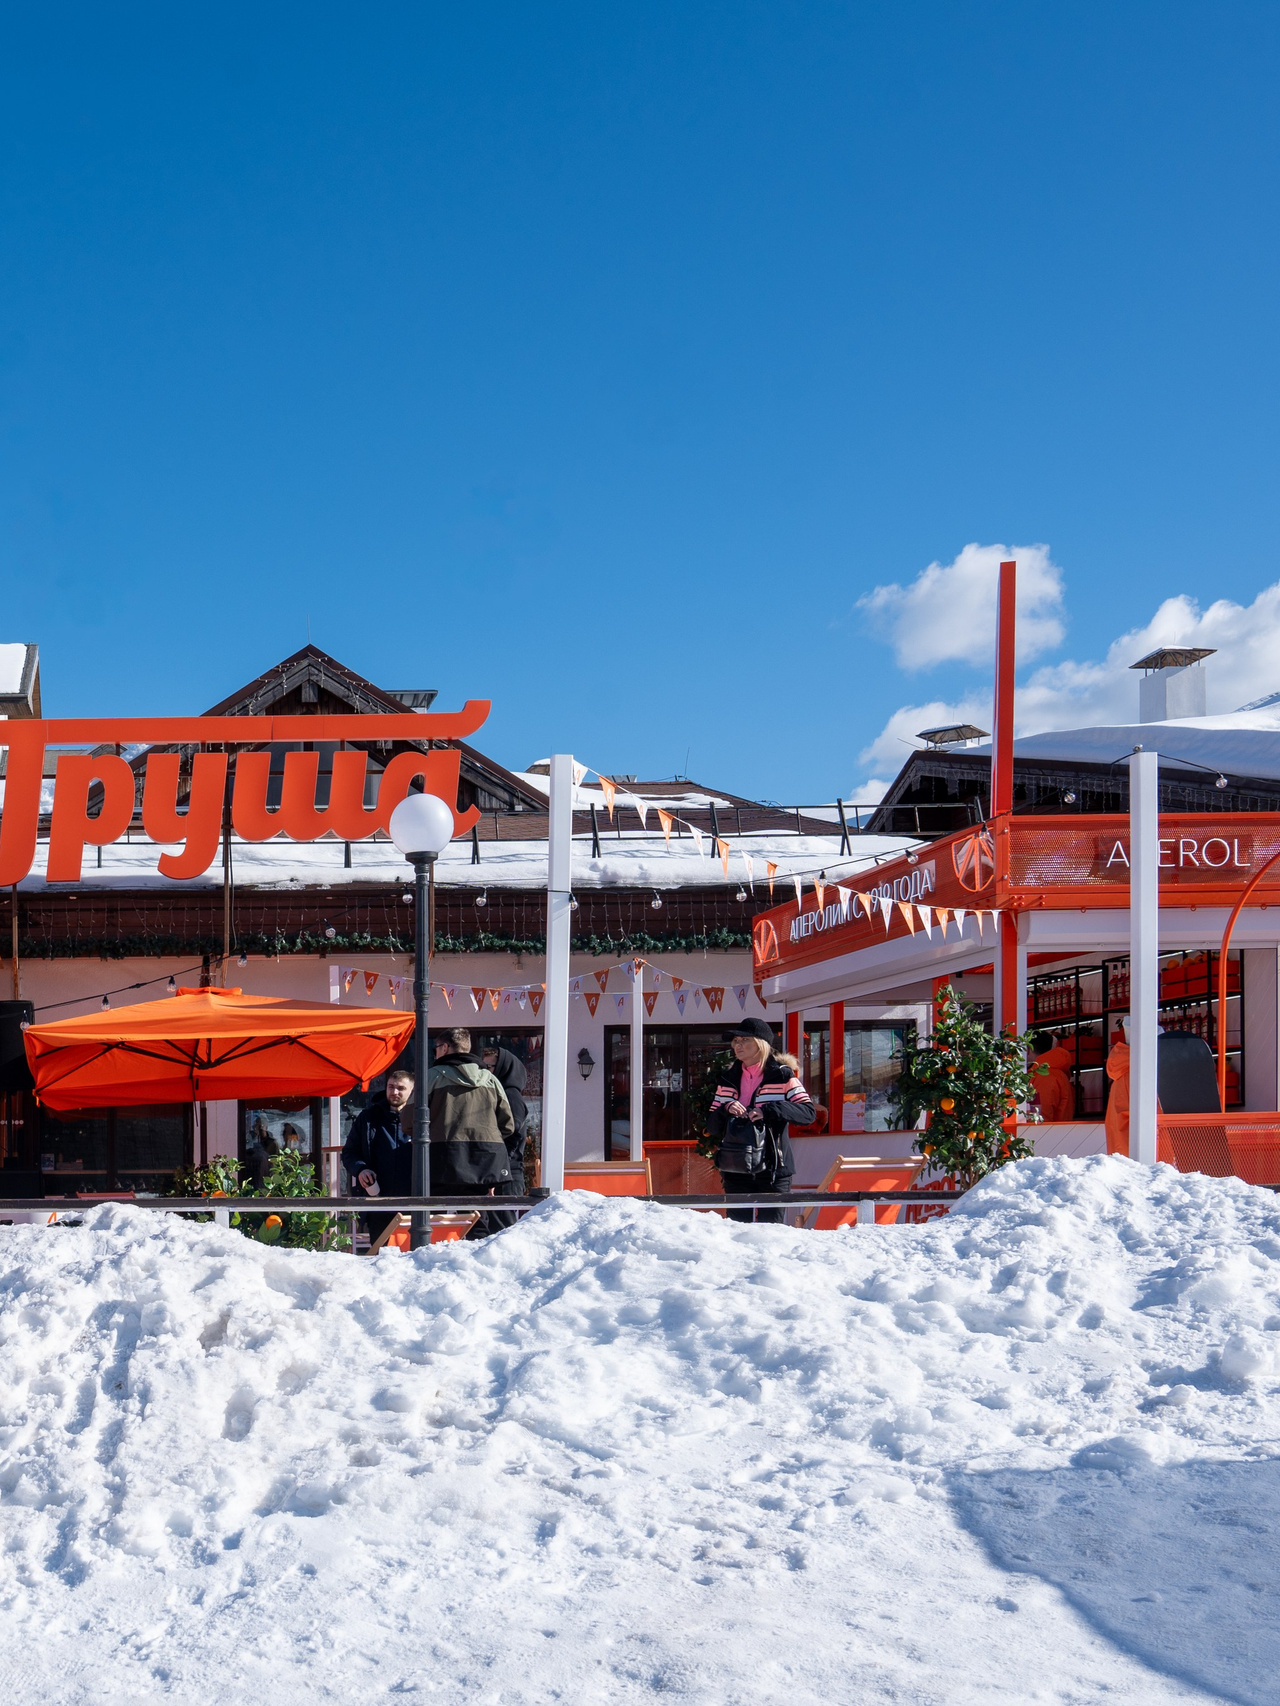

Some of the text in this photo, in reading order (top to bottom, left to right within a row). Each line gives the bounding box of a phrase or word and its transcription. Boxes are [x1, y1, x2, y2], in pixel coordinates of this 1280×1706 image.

[1106, 838, 1251, 868] AEROL
[865, 883, 892, 912] 919
[893, 868, 935, 904] ГОДА
[368, 976, 374, 985] A
[600, 974, 606, 984] A
[394, 981, 400, 990] A
[574, 981, 579, 991] A
[448, 989, 454, 998] A
[477, 991, 483, 1000] A
[492, 991, 499, 1001] A
[504, 994, 510, 1003] A
[709, 992, 716, 1002] A
[739, 988, 746, 999] A
[533, 995, 539, 1005] A
[589, 996, 596, 1007] A
[617, 997, 624, 1007] A
[647, 996, 654, 1006] A
[678, 994, 685, 1004] A
